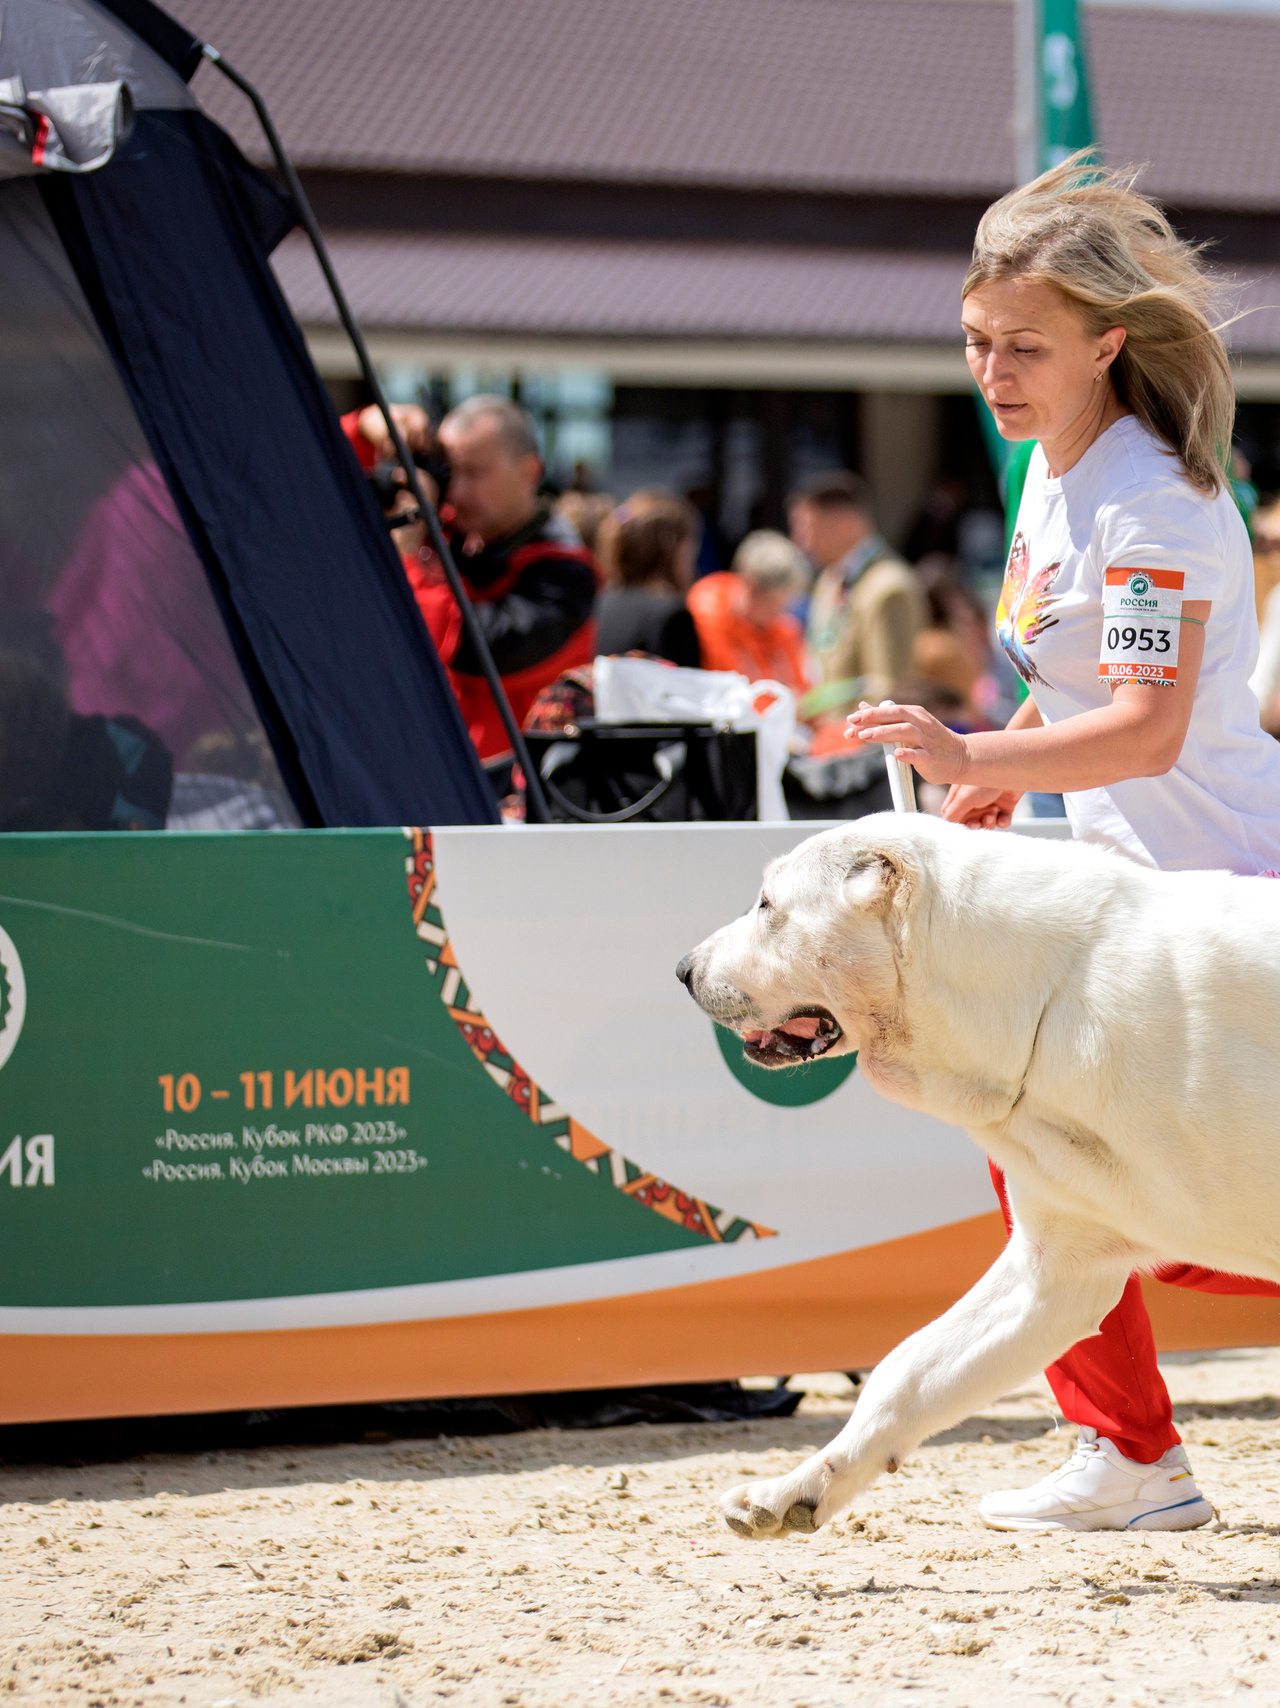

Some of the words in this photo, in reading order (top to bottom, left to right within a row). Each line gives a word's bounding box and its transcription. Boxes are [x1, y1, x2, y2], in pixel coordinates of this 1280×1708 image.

[1120, 597, 1158, 608] РОССИЯ
[1107, 627, 1171, 653] 0953
[1107, 664, 1164, 678] 10.06.2023
[158, 1072, 202, 1114] 10
[239, 1070, 273, 1111] 11
[284, 1066, 410, 1110] ИЮНЯ
[242, 1124, 301, 1154] Кубок
[304, 1122, 349, 1147] РКФ
[351, 1120, 408, 1145] 2023»
[229, 1154, 289, 1185] Кубок
[292, 1153, 370, 1177] Москвы
[372, 1149, 429, 1174] 2023»
